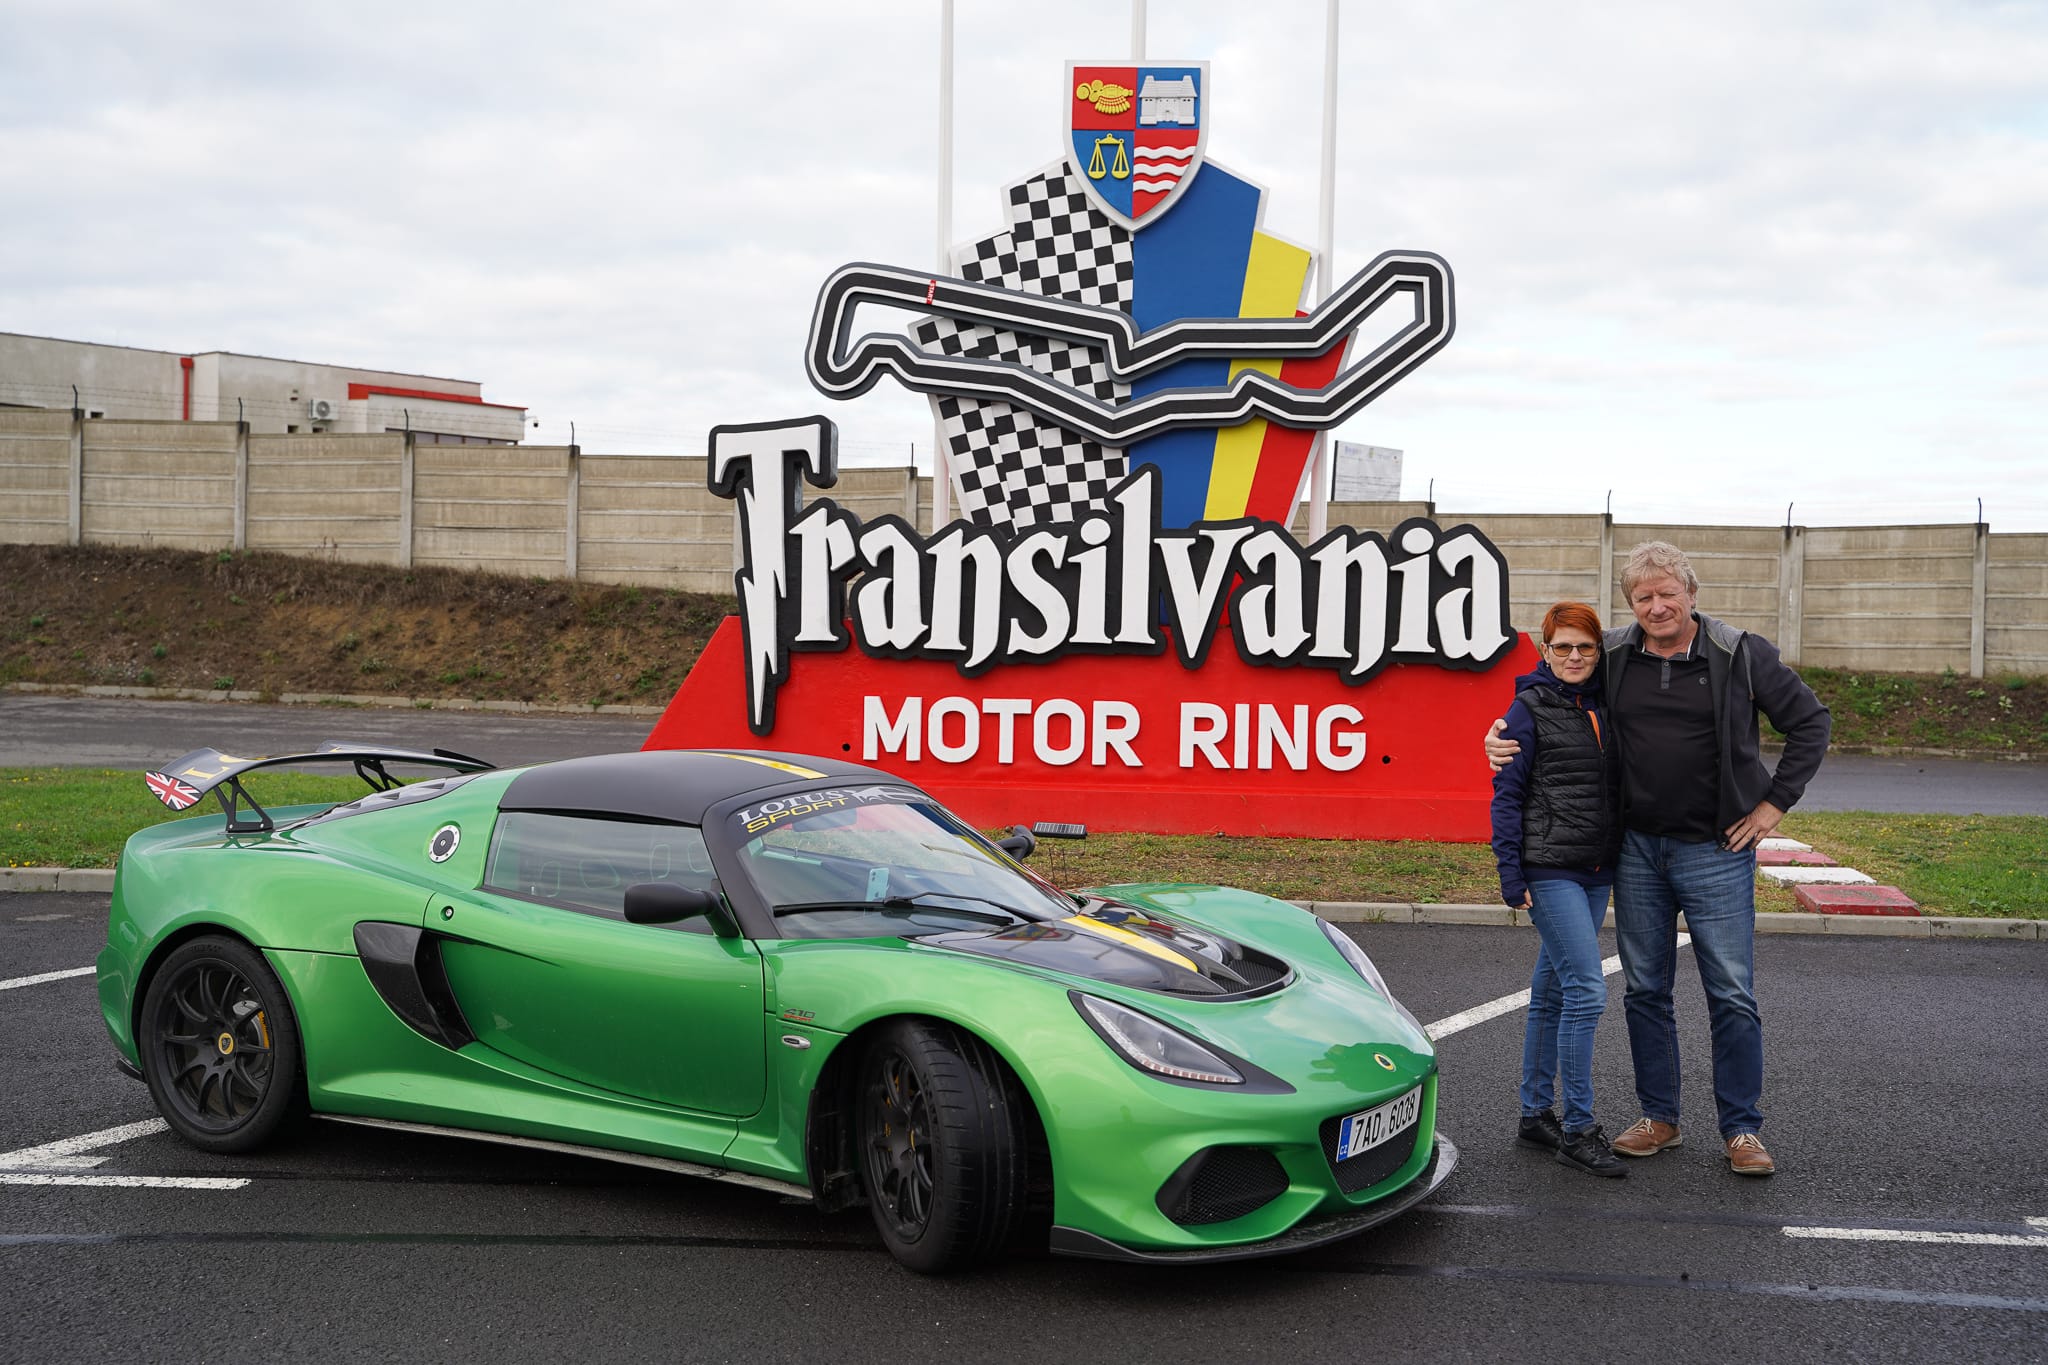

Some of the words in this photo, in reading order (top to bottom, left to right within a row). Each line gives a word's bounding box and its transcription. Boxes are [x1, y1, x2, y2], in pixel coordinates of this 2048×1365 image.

[715, 424, 1509, 725] Transilvania
[863, 696, 1143, 766] MOTOR
[1180, 702, 1366, 771] RING
[737, 790, 844, 825] LOTUS
[747, 797, 848, 833] SPORT
[1353, 1112, 1381, 1151] 7AD
[1389, 1093, 1415, 1134] 6038
